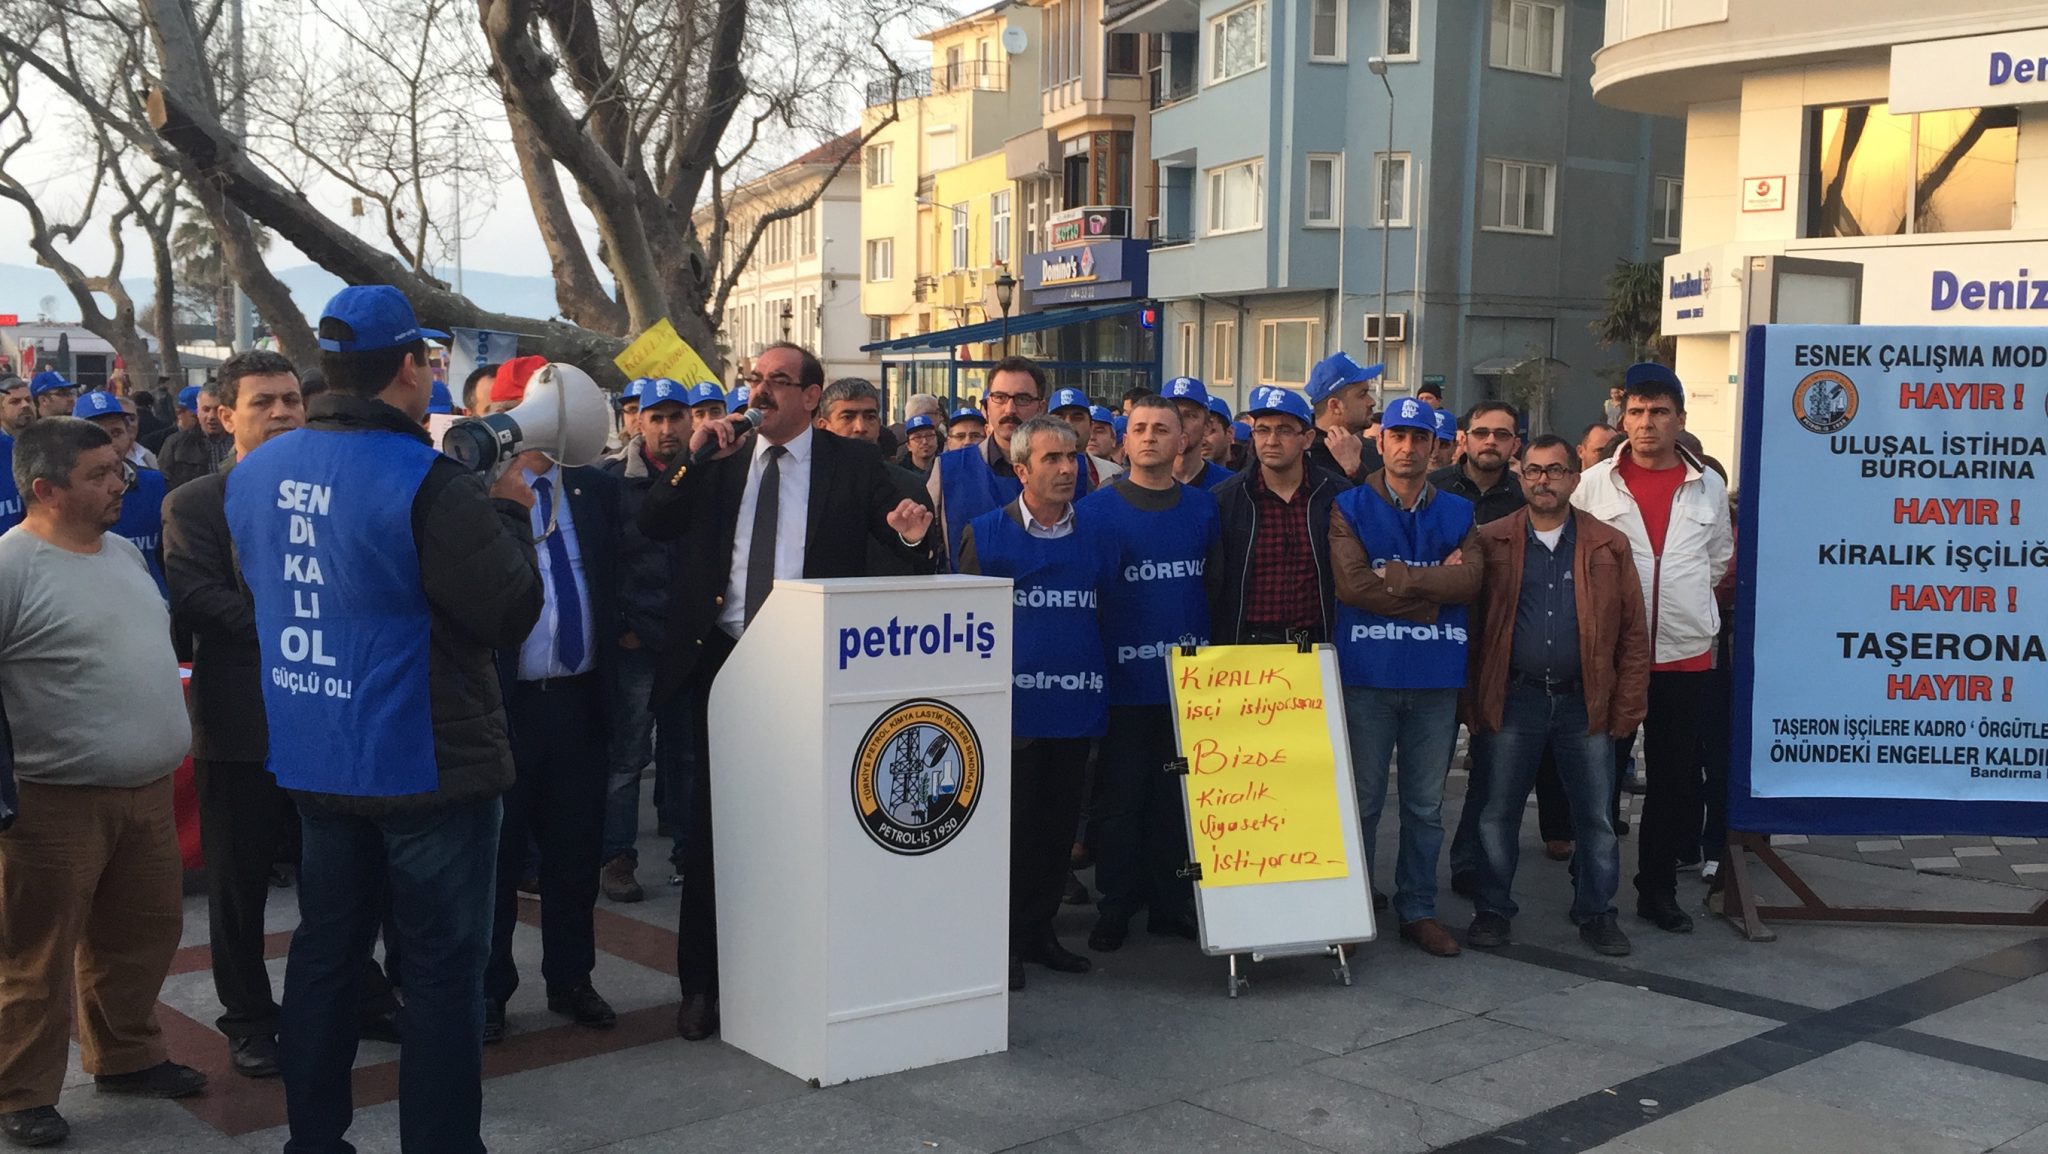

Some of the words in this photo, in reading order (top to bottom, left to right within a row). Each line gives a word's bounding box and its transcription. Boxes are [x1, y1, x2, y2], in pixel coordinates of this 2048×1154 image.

[1931, 268, 2048, 311] Deniz
[1795, 344, 1872, 366] ESNEK
[1879, 345, 1984, 373] ÇALIŞMA
[1992, 346, 2047, 367] MOD
[1899, 383, 2005, 410] HAYIR
[1942, 431, 2047, 455] İSTİHDA
[1861, 453, 2035, 479] BÜROLARINA
[277, 479, 331, 516] SEN
[1893, 498, 1999, 525] HAYIR
[1818, 538, 1936, 565] KİRALIK
[284, 554, 324, 585] KA
[294, 590, 320, 619] LI
[1890, 585, 1996, 612] HAYIR
[280, 626, 336, 666] OL
[839, 612, 995, 670] petrol-iş
[1351, 622, 1468, 645] petrol-iş
[1836, 632, 2047, 667] TAŞERONA
[272, 667, 320, 695] GÜÇLÜ
[324, 678, 352, 699] OL!
[1887, 674, 1992, 701] HAYIR
[866, 729, 890, 759] PETROL
[915, 710, 944, 720] LASTİK
[1772, 718, 1839, 740] TAŞERON
[1844, 714, 1909, 740] İŞÇİLERE
[1914, 719, 1966, 737] KADRO
[1770, 740, 1871, 763] ÖNÜNDEKİ
[1877, 746, 1979, 765] ENGELLER
[1985, 747, 2048, 766] KALDI
[1970, 767, 2041, 779] Bandırma
[878, 822, 931, 845] PETROL-İŞ
[933, 817, 958, 840] 1950
